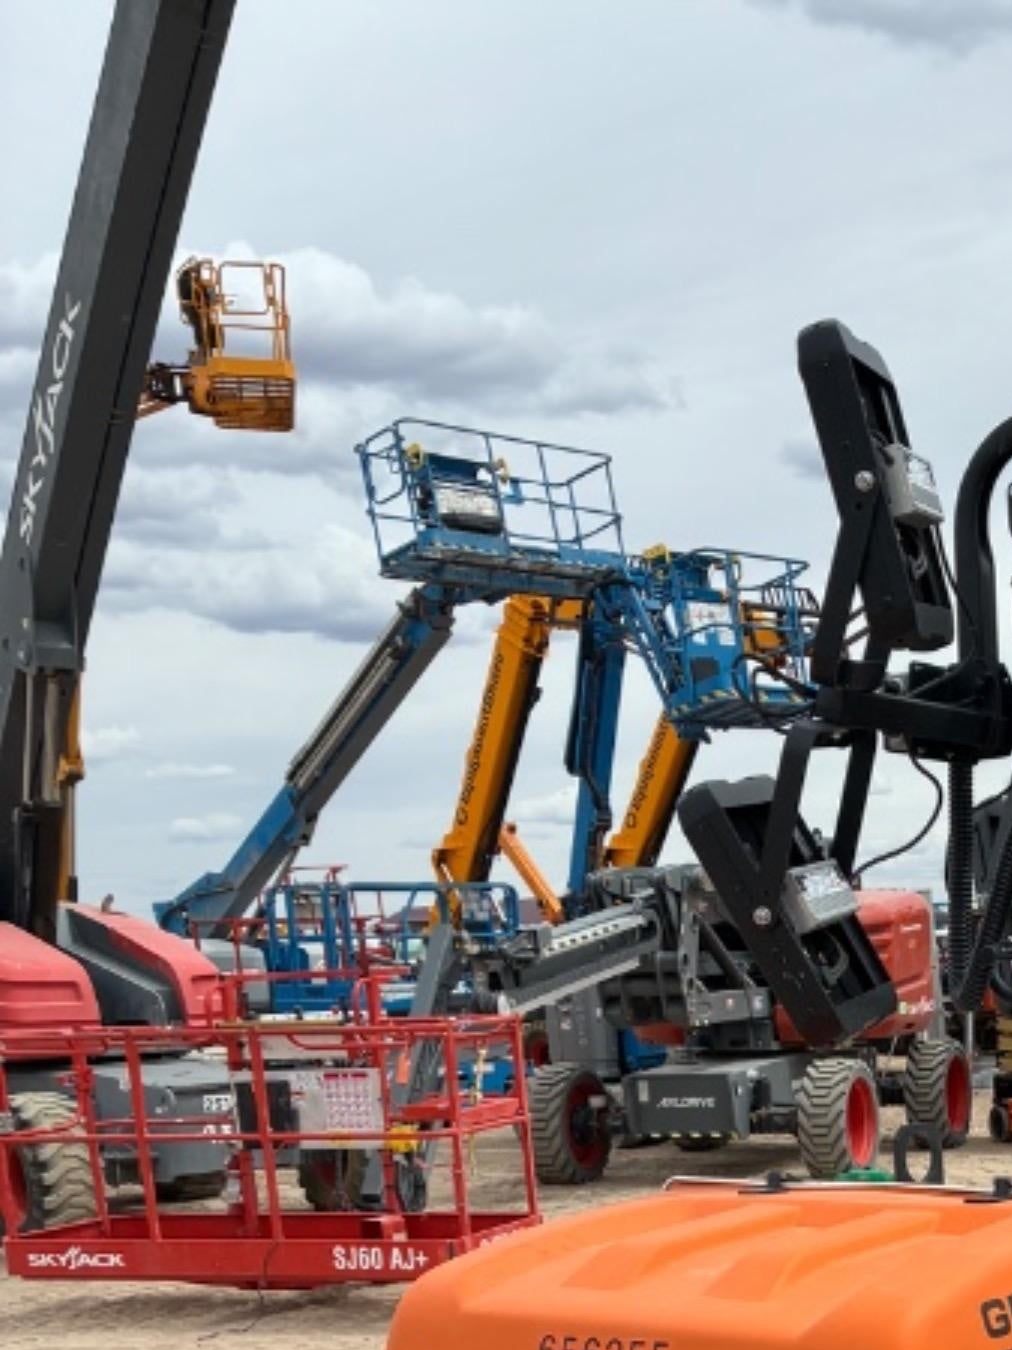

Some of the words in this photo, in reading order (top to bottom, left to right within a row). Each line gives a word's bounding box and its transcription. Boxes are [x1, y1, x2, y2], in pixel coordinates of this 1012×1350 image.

[19, 292, 82, 546] SKYJACK
[27, 1246, 126, 1269] SKYJACK
[332, 1245, 385, 1271] SJ60
[389, 1246, 430, 1271] AJ+
